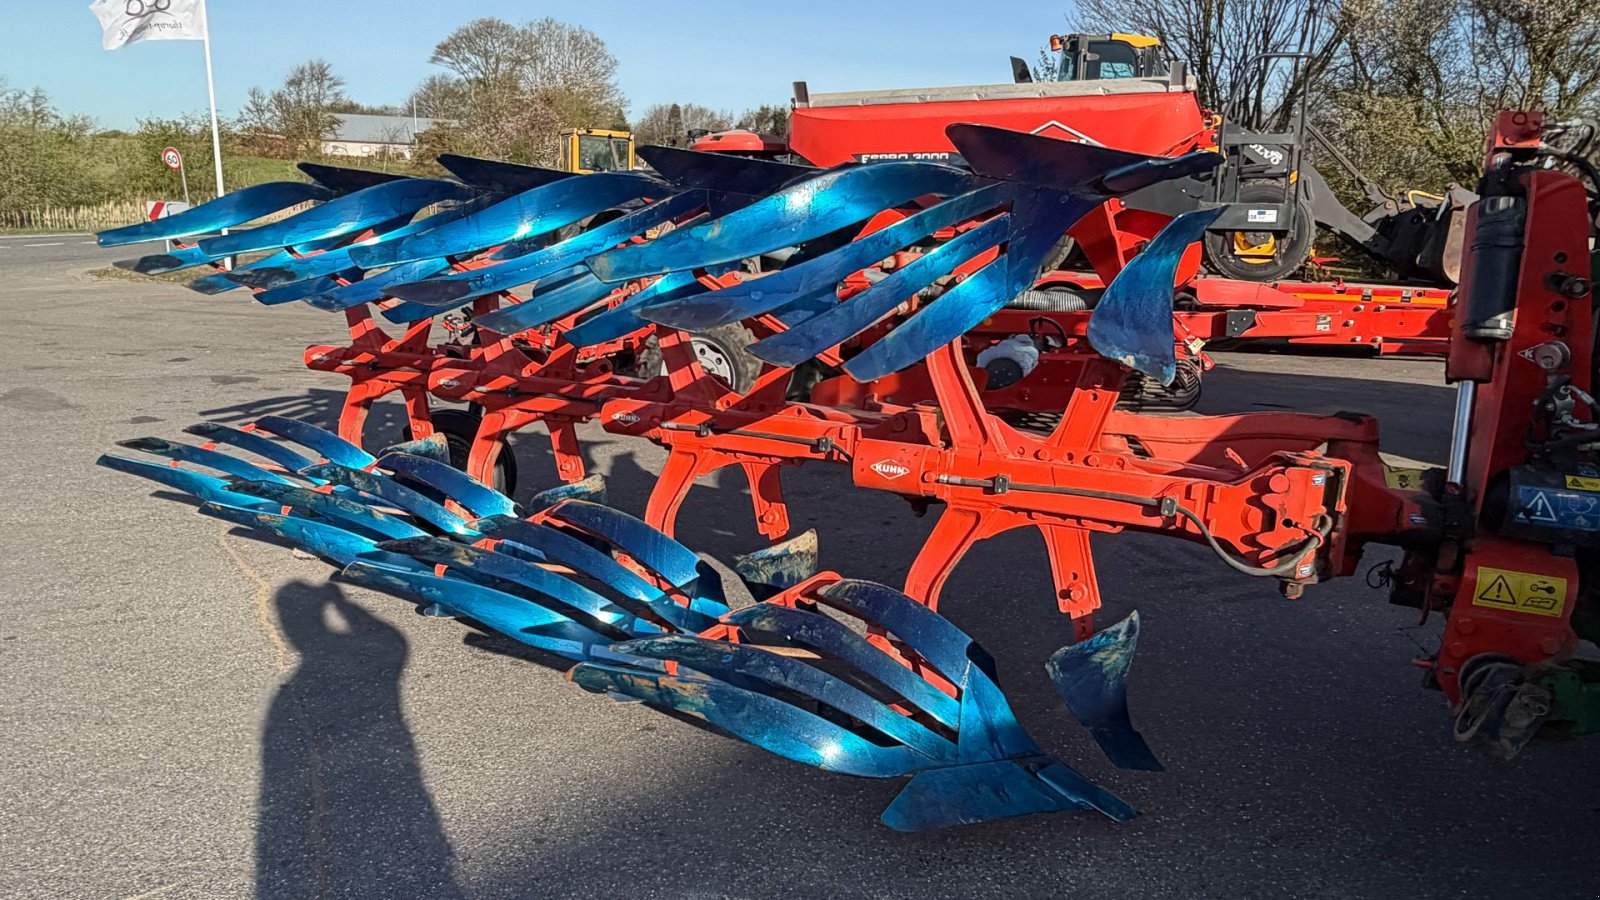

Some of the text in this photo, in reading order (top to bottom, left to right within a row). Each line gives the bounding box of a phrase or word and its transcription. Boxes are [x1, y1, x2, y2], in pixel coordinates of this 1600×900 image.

[167, 154, 178, 164] 60
[1250, 144, 1280, 165] LVO
[876, 463, 905, 475] KUHN
